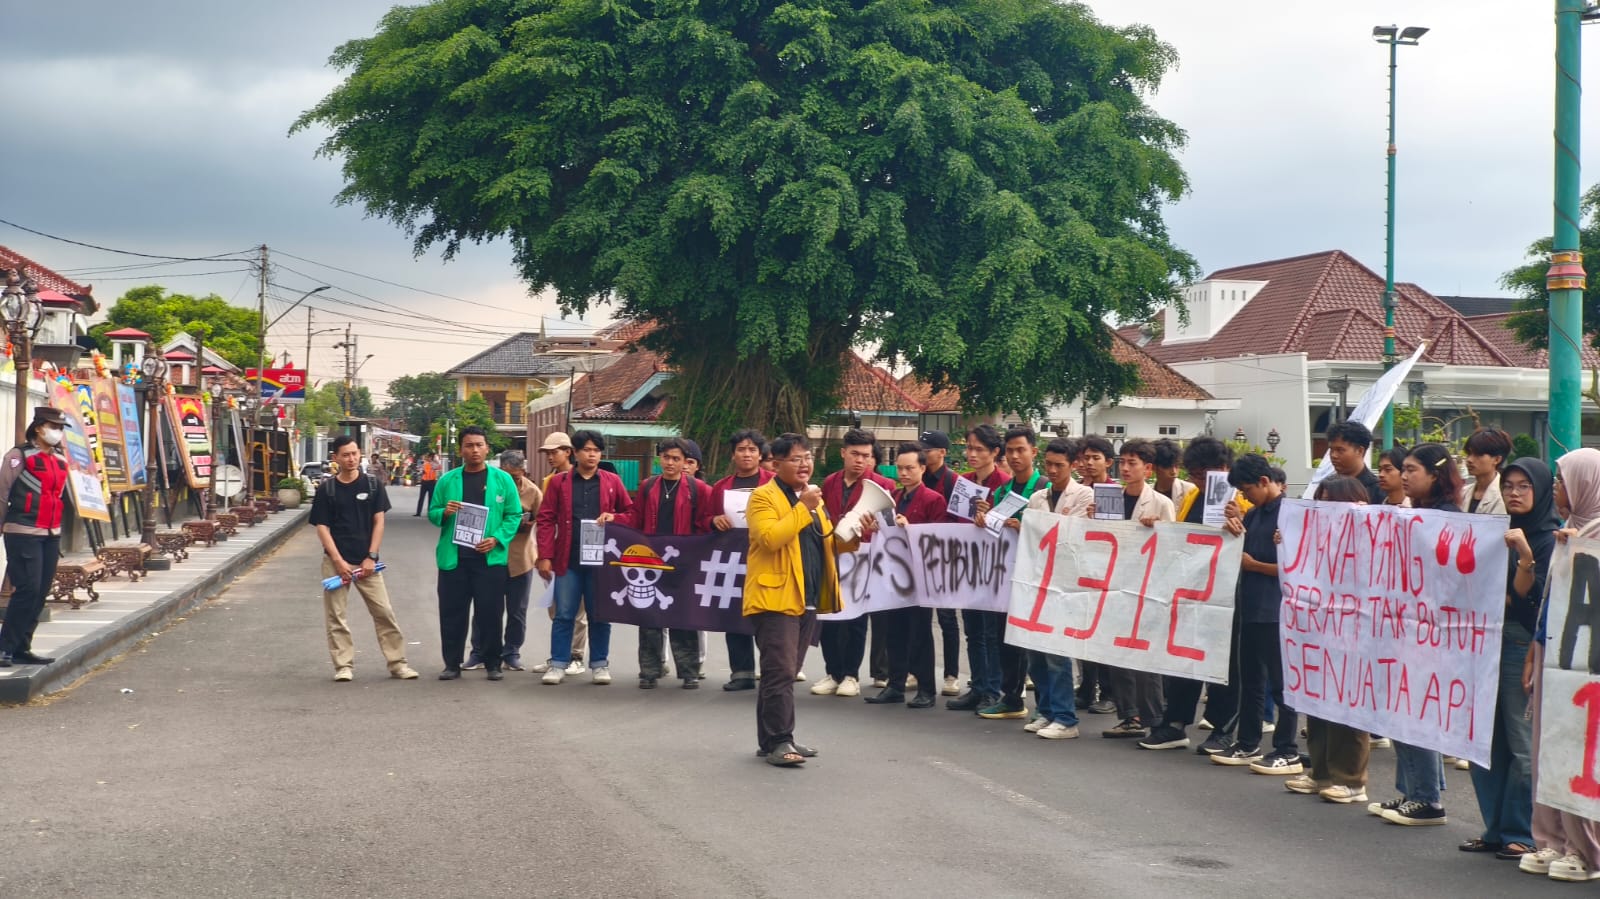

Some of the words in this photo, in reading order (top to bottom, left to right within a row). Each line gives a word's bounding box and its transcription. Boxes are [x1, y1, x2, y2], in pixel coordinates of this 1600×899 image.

[279, 373, 301, 383] atm
[917, 532, 1010, 598] PEMBUNUH
[1007, 521, 1223, 662] 1312
[1283, 508, 1356, 586] JIWA
[1364, 511, 1424, 597] YANG
[1281, 582, 1362, 640] BERAPI
[1368, 596, 1407, 640] TAK
[1416, 601, 1487, 655] BUTUH
[1285, 638, 1411, 716] SENJATA
[1420, 672, 1475, 742] API
